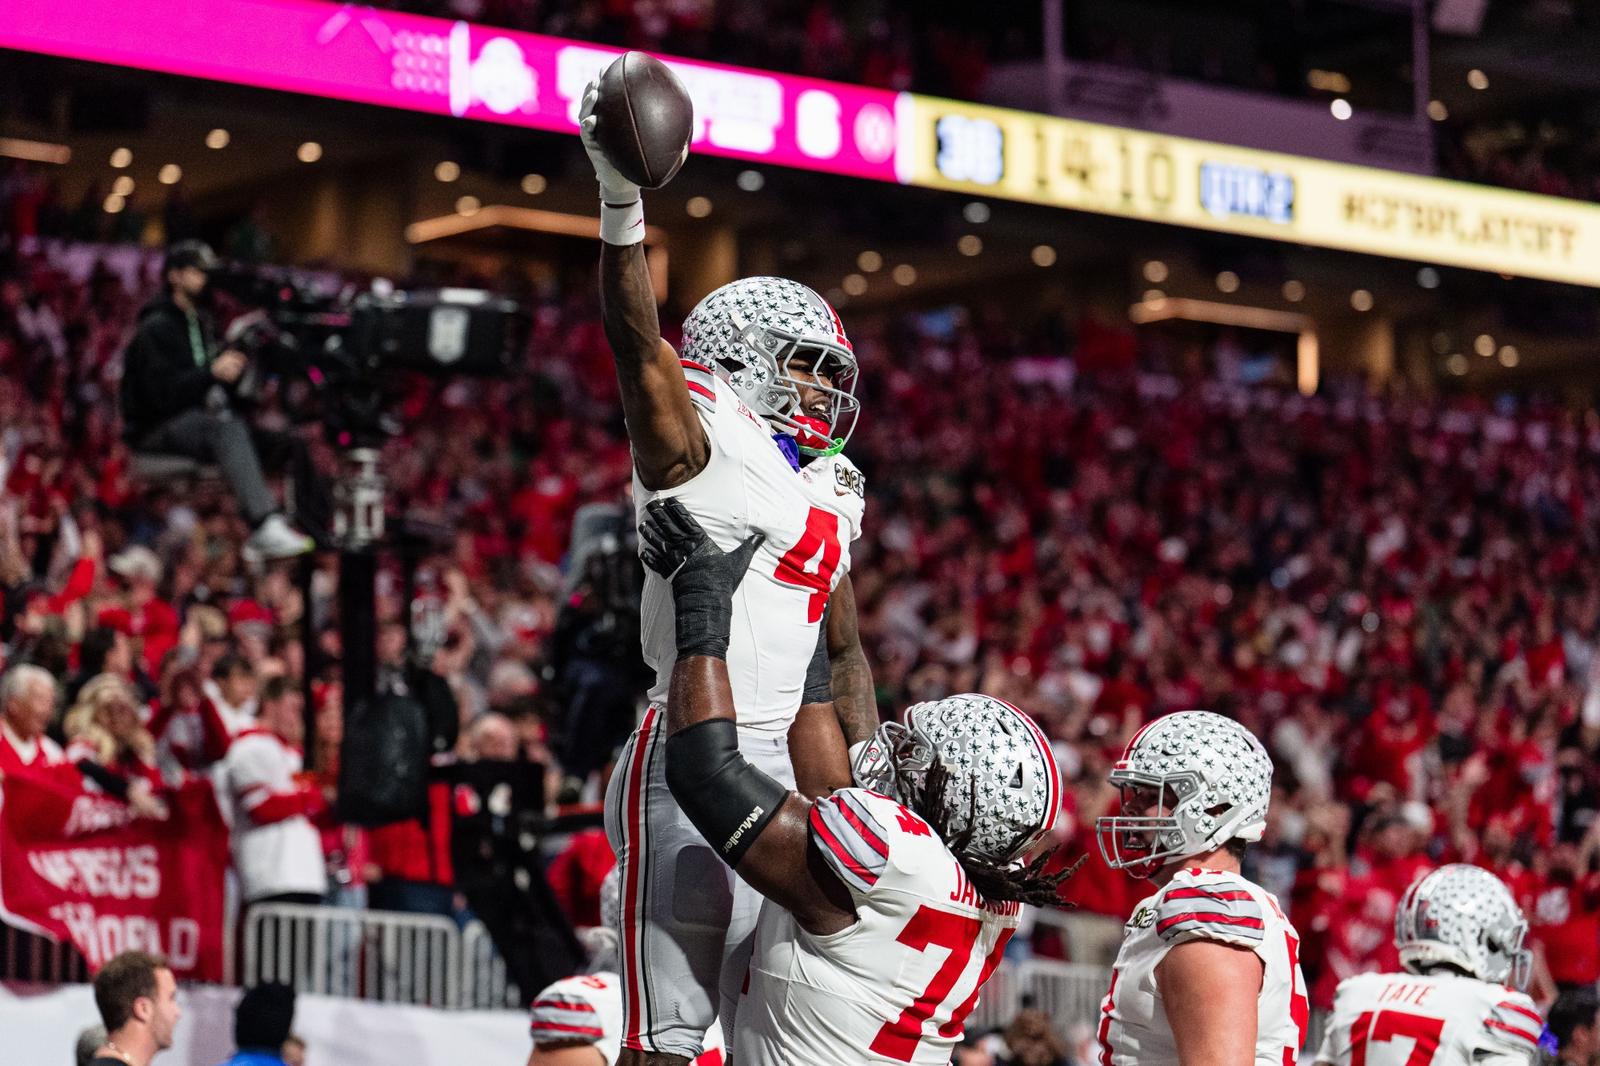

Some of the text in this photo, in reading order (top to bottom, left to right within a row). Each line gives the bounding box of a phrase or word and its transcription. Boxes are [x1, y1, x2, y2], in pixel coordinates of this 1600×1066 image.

[773, 506, 842, 624] 4
[722, 811, 760, 854] Mueller
[1376, 981, 1436, 1007] TATE
[1350, 1010, 1446, 1066] 17
